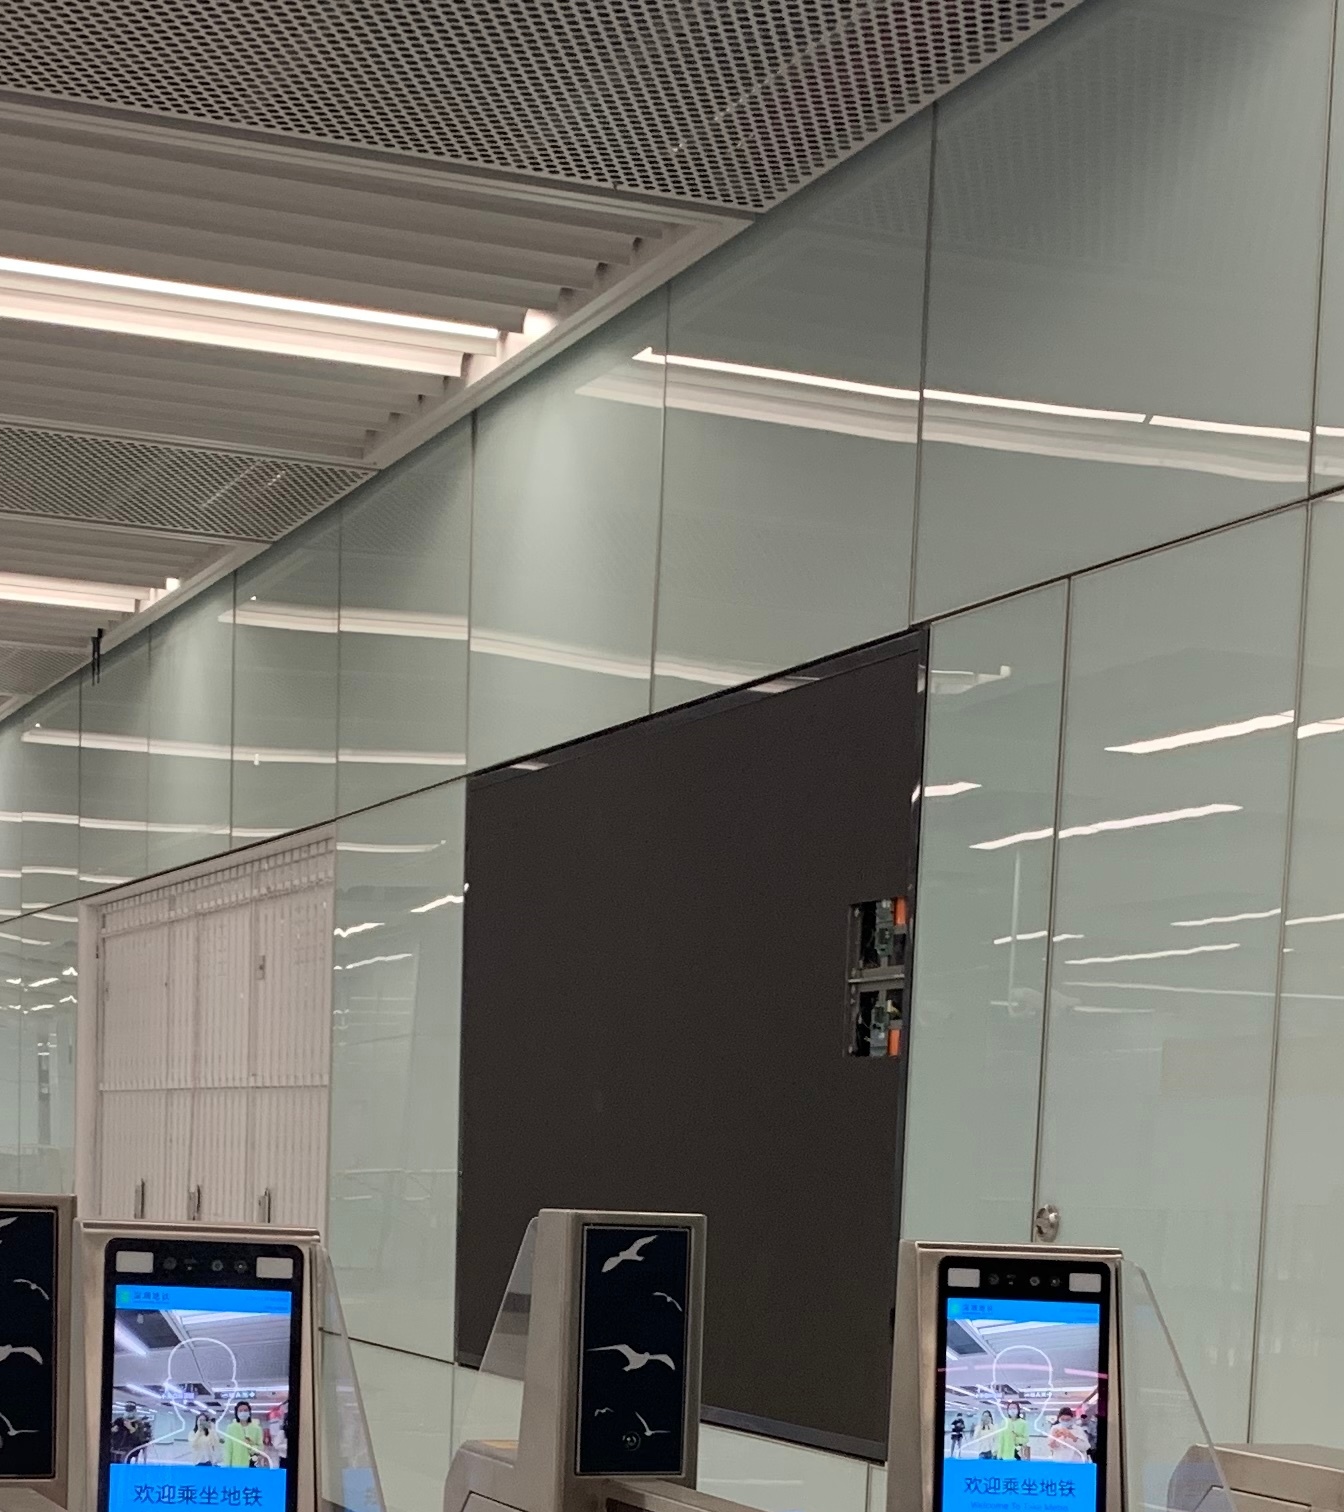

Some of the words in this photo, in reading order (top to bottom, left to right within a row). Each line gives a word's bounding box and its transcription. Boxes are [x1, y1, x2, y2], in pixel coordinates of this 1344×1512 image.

[132, 1483, 263, 1508] 欢迎乘坐地铁
[963, 1475, 1077, 1498] 欢迎乘坐地铁
